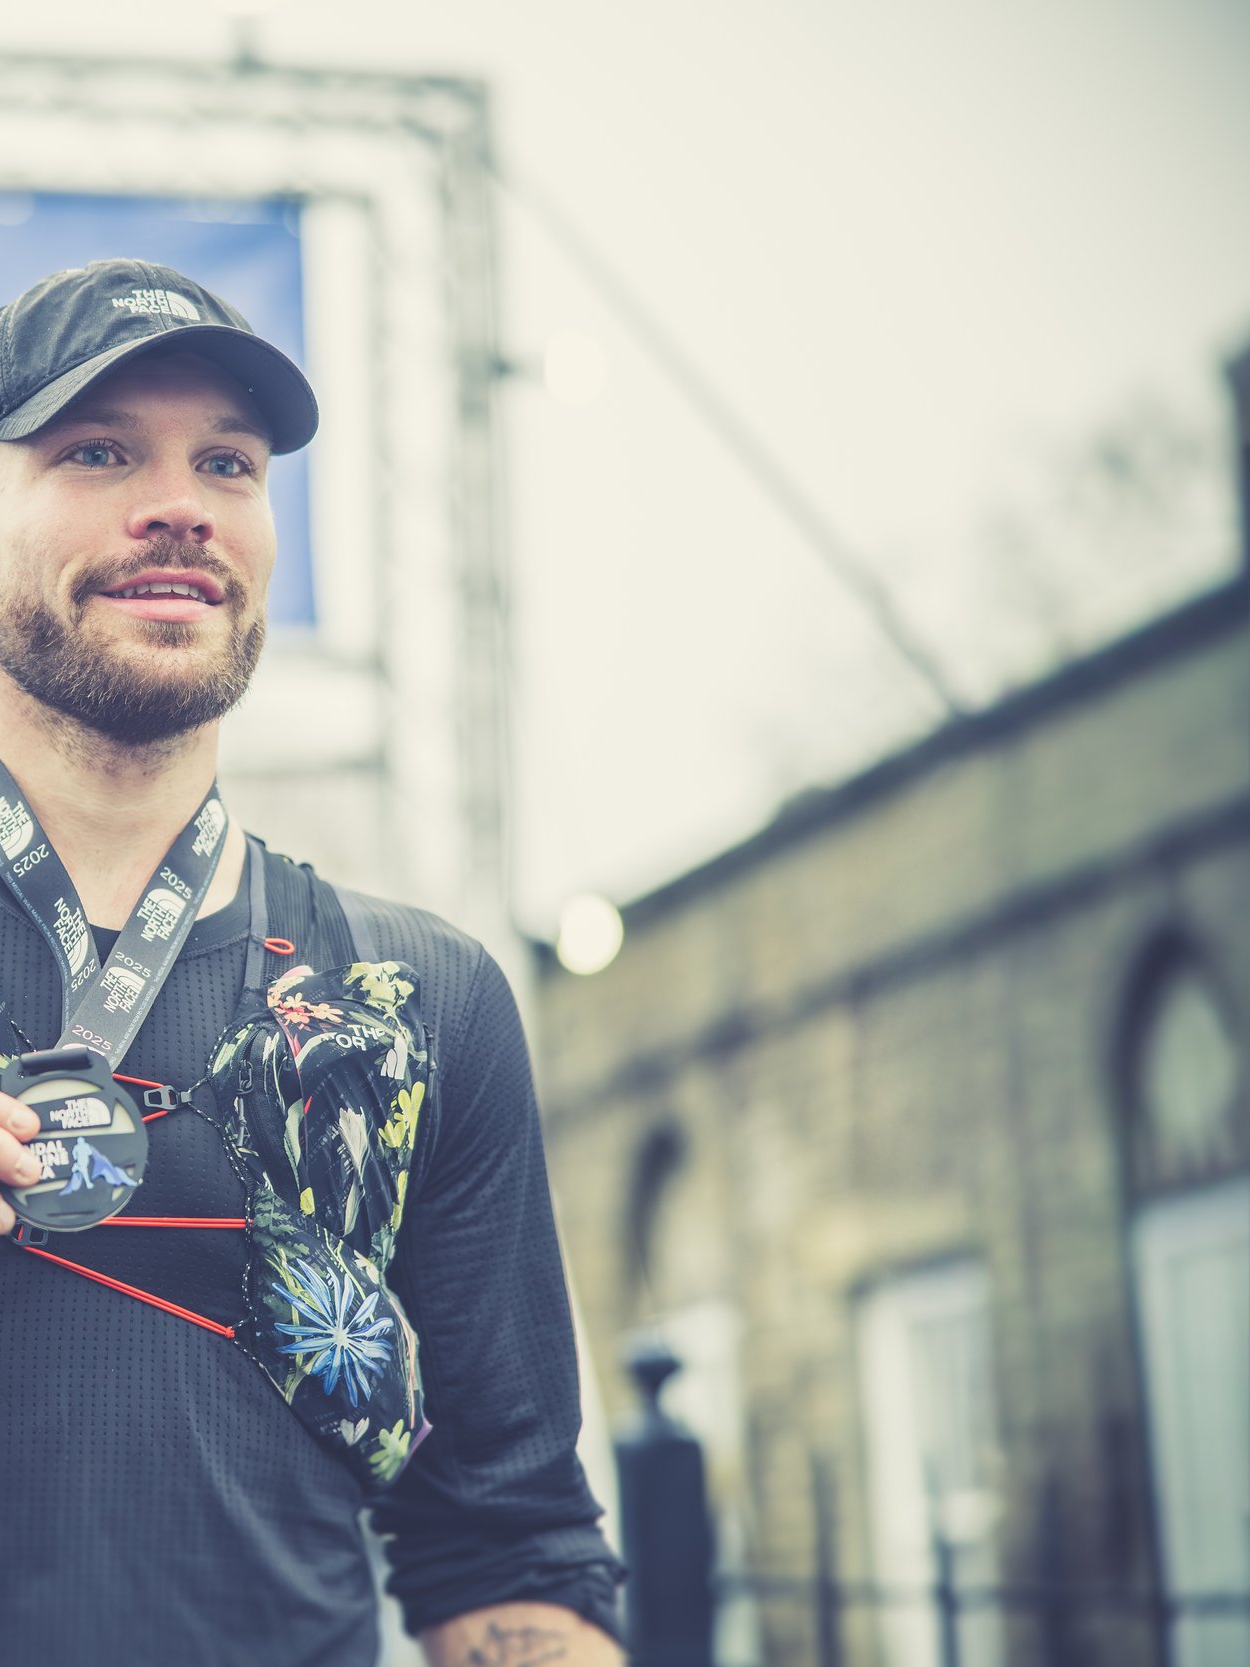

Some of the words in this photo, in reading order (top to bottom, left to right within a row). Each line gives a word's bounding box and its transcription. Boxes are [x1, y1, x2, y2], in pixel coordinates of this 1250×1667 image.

[112, 297, 169, 308] NORTH
[132, 289, 166, 300] THE
[130, 305, 171, 314] FACE
[13, 800, 31, 826] THE
[193, 806, 212, 831] THE
[12, 843, 50, 878] 2025
[159, 867, 193, 900] 2025
[54, 897, 81, 946] NORTH
[72, 907, 87, 936] THE
[136, 896, 156, 921] THE
[141, 904, 168, 942] NORTH
[156, 910, 178, 941] FACE
[53, 919, 74, 955] FACE
[71, 958, 97, 993] 2025
[114, 951, 152, 978] 2025
[100, 971, 118, 992] THE
[103, 979, 128, 1014] NORTH
[118, 986, 138, 1014] FACE
[71, 1024, 112, 1050] 2025
[64, 1098, 87, 1111] THE
